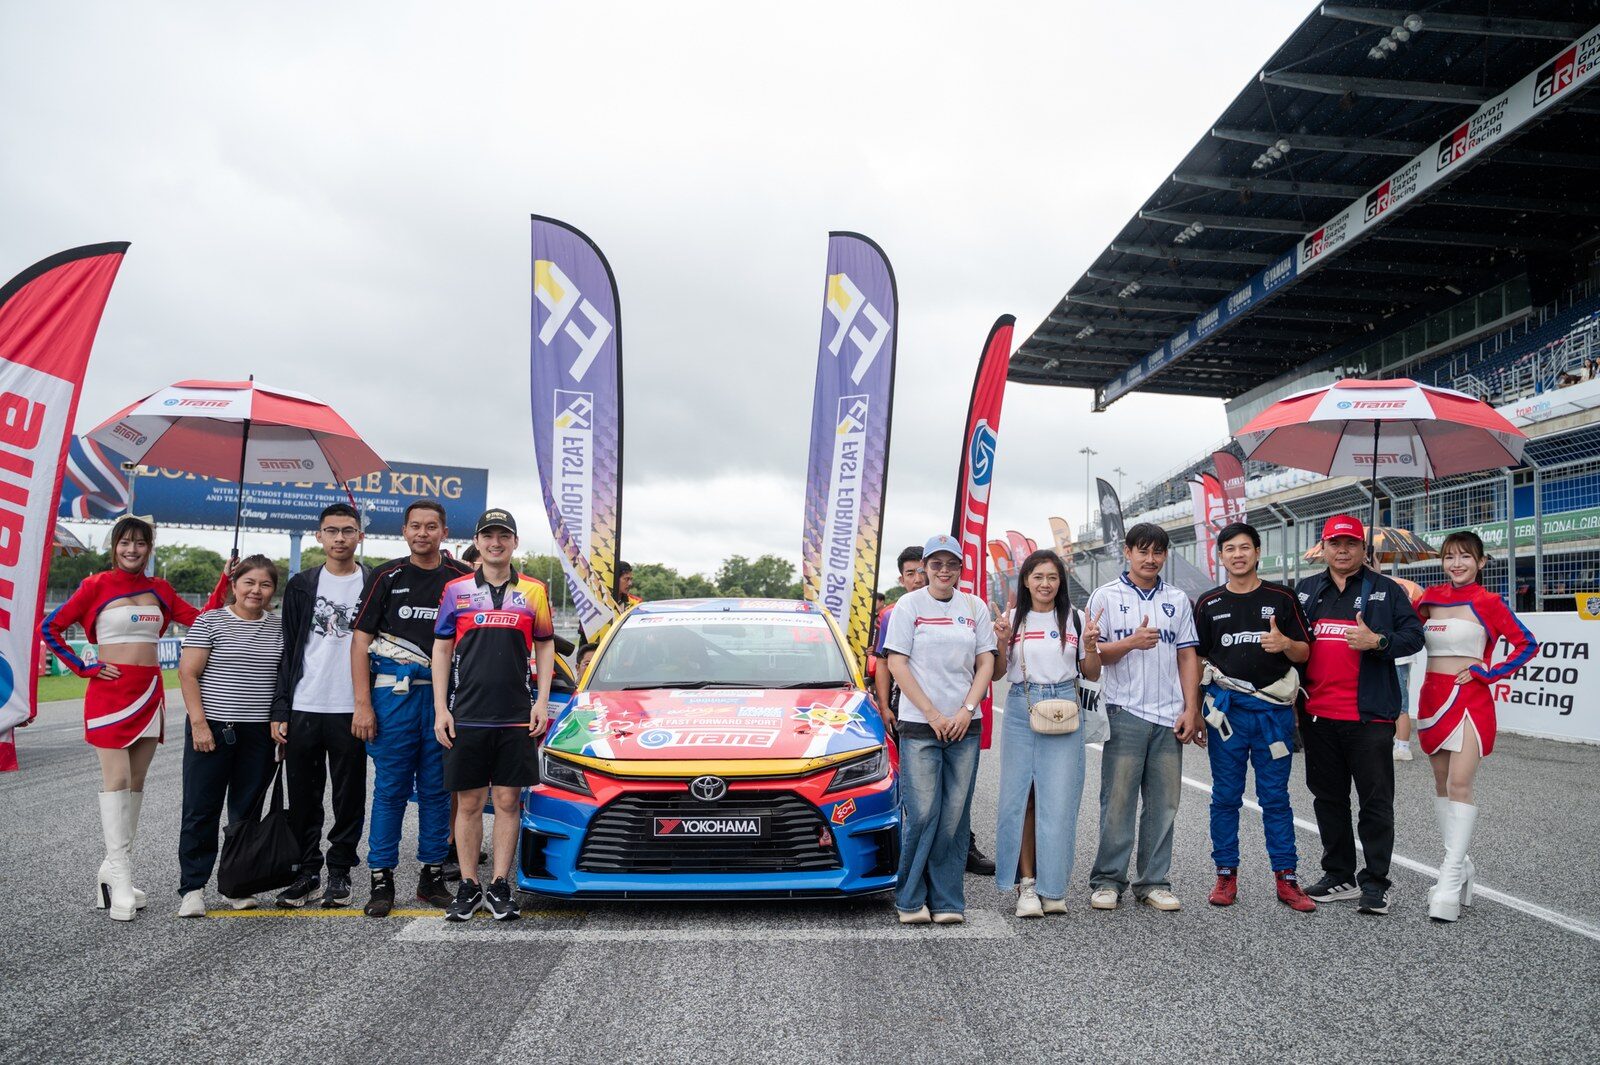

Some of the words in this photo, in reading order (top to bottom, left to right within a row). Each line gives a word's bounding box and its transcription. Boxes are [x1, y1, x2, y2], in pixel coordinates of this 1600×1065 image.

[1471, 97, 1508, 128] TOYOTA
[1469, 111, 1504, 139] GAZOO
[1468, 123, 1502, 150] Racing
[1392, 161, 1421, 186] TOYOTA
[1390, 173, 1417, 195] GAZOO
[1389, 184, 1416, 205] Racing
[1324, 223, 1347, 241] GAZOO
[1325, 213, 1349, 233] TOYOTA
[178, 398, 232, 409] Trane
[1352, 400, 1407, 409] Trane
[213, 487, 234, 495] WITH
[251, 490, 282, 498] UTMOST
[283, 491, 314, 500] RESPECT
[315, 494, 335, 502] FROM
[389, 472, 463, 499] KING
[206, 494, 223, 502] AND
[292, 500, 318, 508] CHANG
[377, 505, 405, 513] CIRCUIT
[240, 508, 268, 520] Chang
[270, 512, 320, 521] INTERNATIONAL
[1506, 517, 1577, 538] ITERNTIONAL
[138, 614, 160, 622] Trane
[412, 606, 439, 620] Tra
[485, 614, 517, 625] Trane
[1114, 628, 1176, 644] THAND
[1232, 631, 1267, 645] Tran
[1500, 638, 1589, 660] TOTA
[1503, 666, 1579, 685] AZOO
[1494, 684, 1574, 716] Racing
[666, 718, 690, 726] FAST
[692, 718, 742, 726] FORWARD
[744, 718, 778, 727] SPORT
[675, 729, 776, 746] Trane
[682, 820, 758, 834] YOKOHAMA
